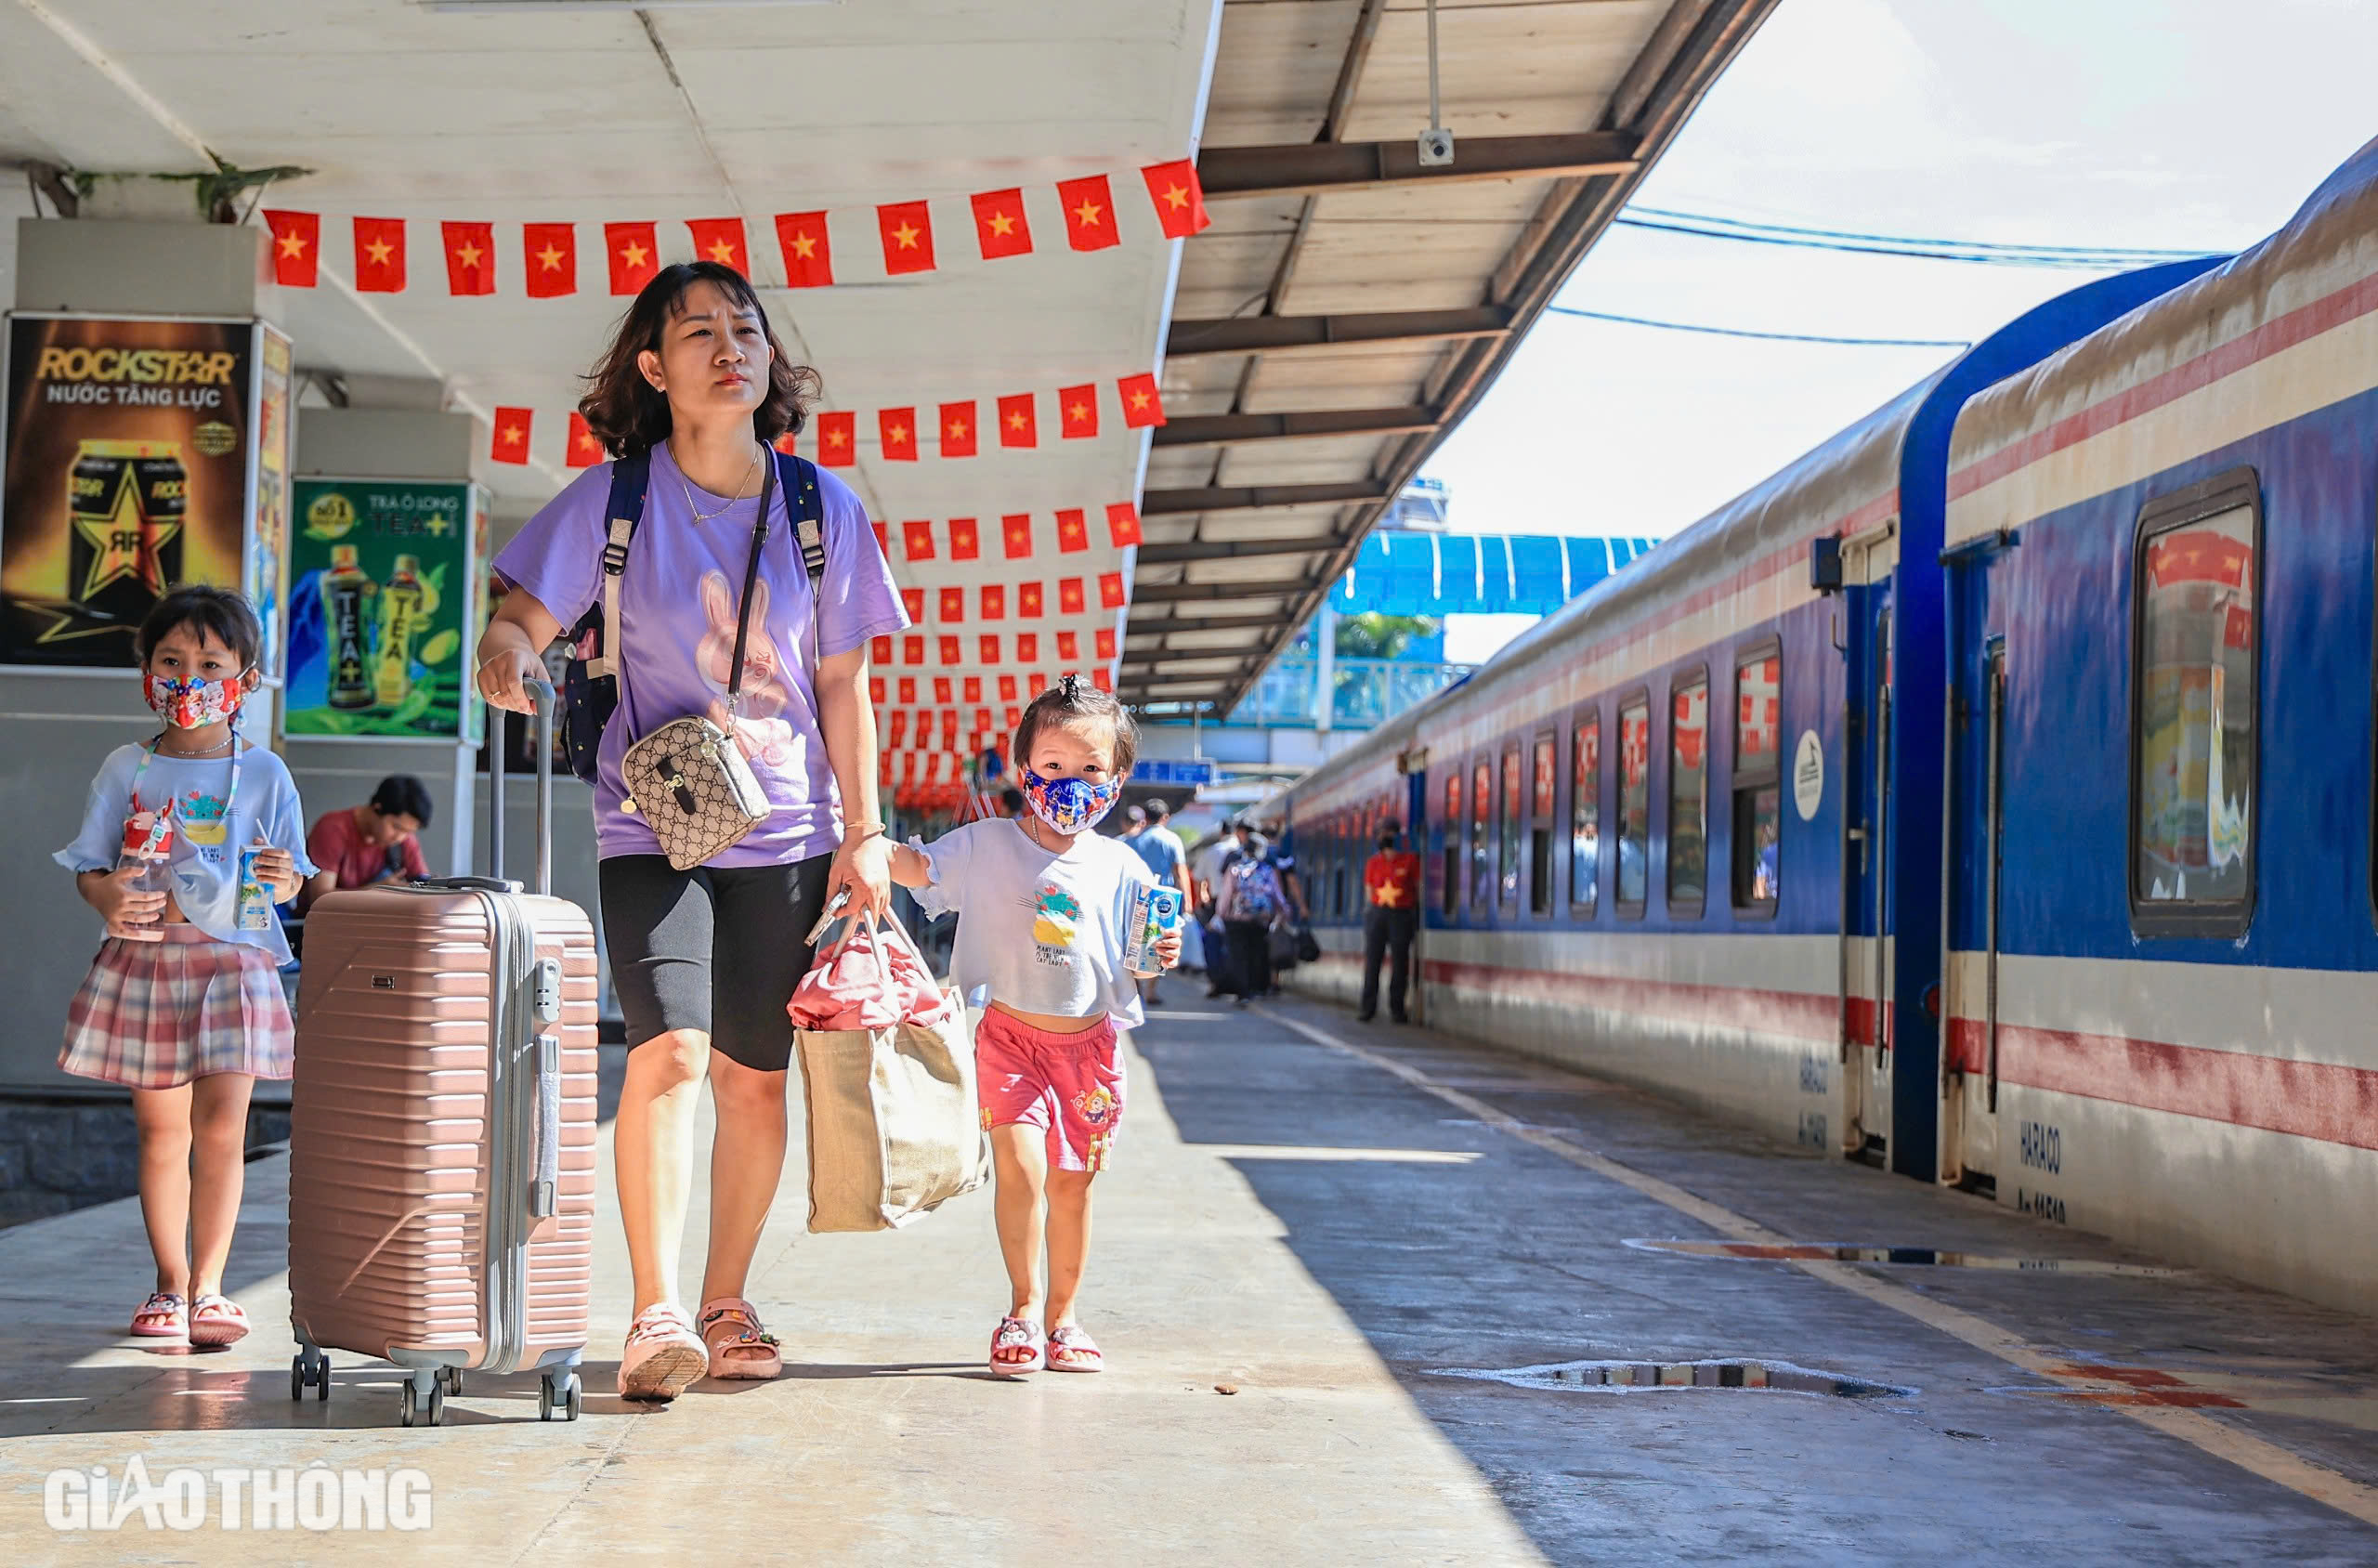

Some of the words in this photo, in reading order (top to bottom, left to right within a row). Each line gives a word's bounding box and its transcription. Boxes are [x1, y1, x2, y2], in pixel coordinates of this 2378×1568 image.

[36, 346, 235, 385] ROCKSTAR
[47, 382, 111, 403] NƯỚC
[114, 384, 171, 406] TĂNG
[178, 386, 222, 412] LỰC
[416, 495, 459, 512] LONG
[2020, 1120, 2060, 1175] HARACO
